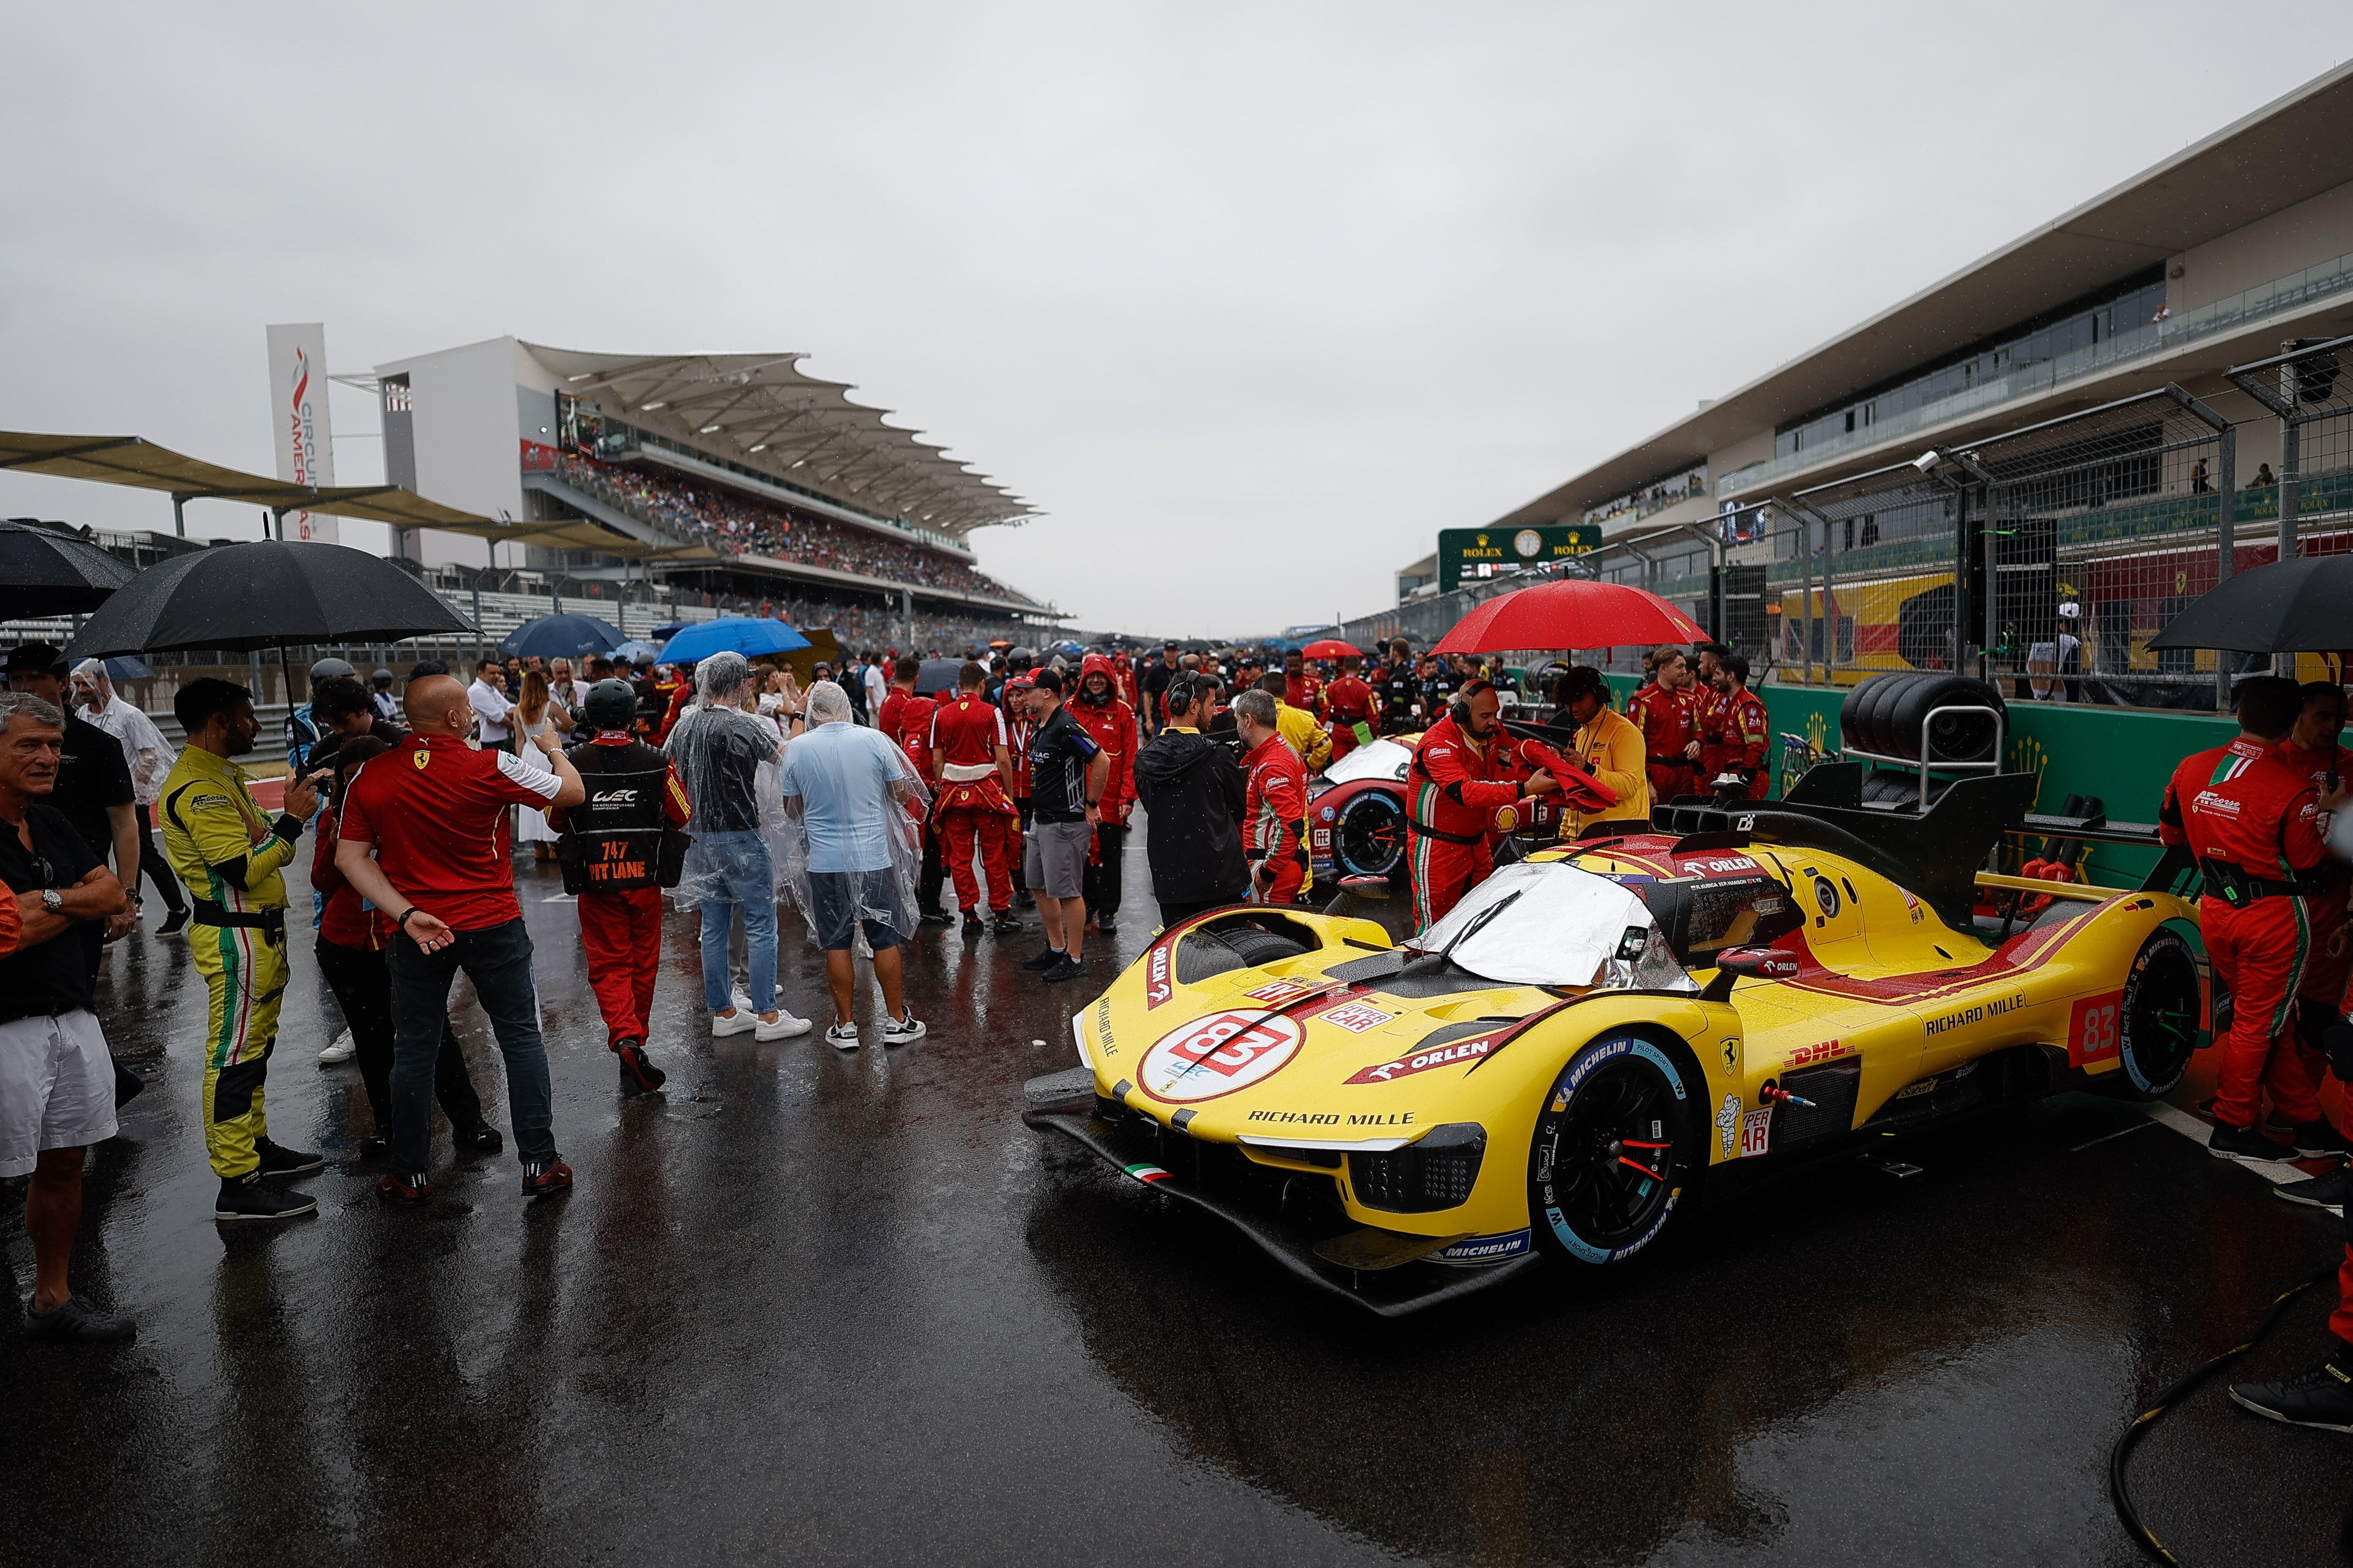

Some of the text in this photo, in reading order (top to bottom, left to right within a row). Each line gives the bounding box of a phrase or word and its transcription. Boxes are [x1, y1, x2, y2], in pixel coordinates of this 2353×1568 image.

[302, 403, 316, 485] CIRCUI
[290, 414, 311, 541] AMERAS
[1462, 548, 1503, 557] ROLEX
[1553, 545, 1593, 555] ROLEX
[592, 789, 639, 802] WEC
[1344, 793, 1369, 815] MICHELIN
[1324, 808, 1334, 821] hp
[601, 841, 629, 861] 747
[589, 861, 645, 881] PIT LANE
[1709, 857, 1757, 873] ORLEN
[2148, 937, 2179, 957] MICHELIN
[1152, 946, 1167, 983] ORLEN
[1777, 962, 1797, 971] ORLEN
[1245, 982, 1302, 1000] HY
[1326, 1010, 1374, 1030] CAR
[1344, 1004, 1388, 1023] HYPER
[1926, 994, 2023, 1036] RICHARD MILLE
[1099, 996, 1118, 1057] RICHARD MILLE
[2083, 1004, 2115, 1053] 83
[1184, 1021, 1279, 1067] 83
[1789, 1039, 1846, 1066] DHL
[1411, 1040, 1489, 1069] ORLEN
[1570, 1041, 1627, 1088] MICHELIN
[1637, 1044, 1670, 1068] PILOT SPORT
[1171, 1061, 1211, 1077] WEC
[1675, 1081, 1684, 1095] W
[2150, 1073, 2182, 1094] MICHELIN
[1248, 1110, 1415, 1125] RICHARD MILLE
[1742, 1110, 1769, 1129] PER
[1741, 1126, 1766, 1152] AR
[1550, 1212, 1562, 1227] W
[1613, 1212, 1667, 1261] MICHELIN
[1446, 1239, 1522, 1257] MICHELIN
[1568, 1238, 1604, 1260] PILOT SPORT
